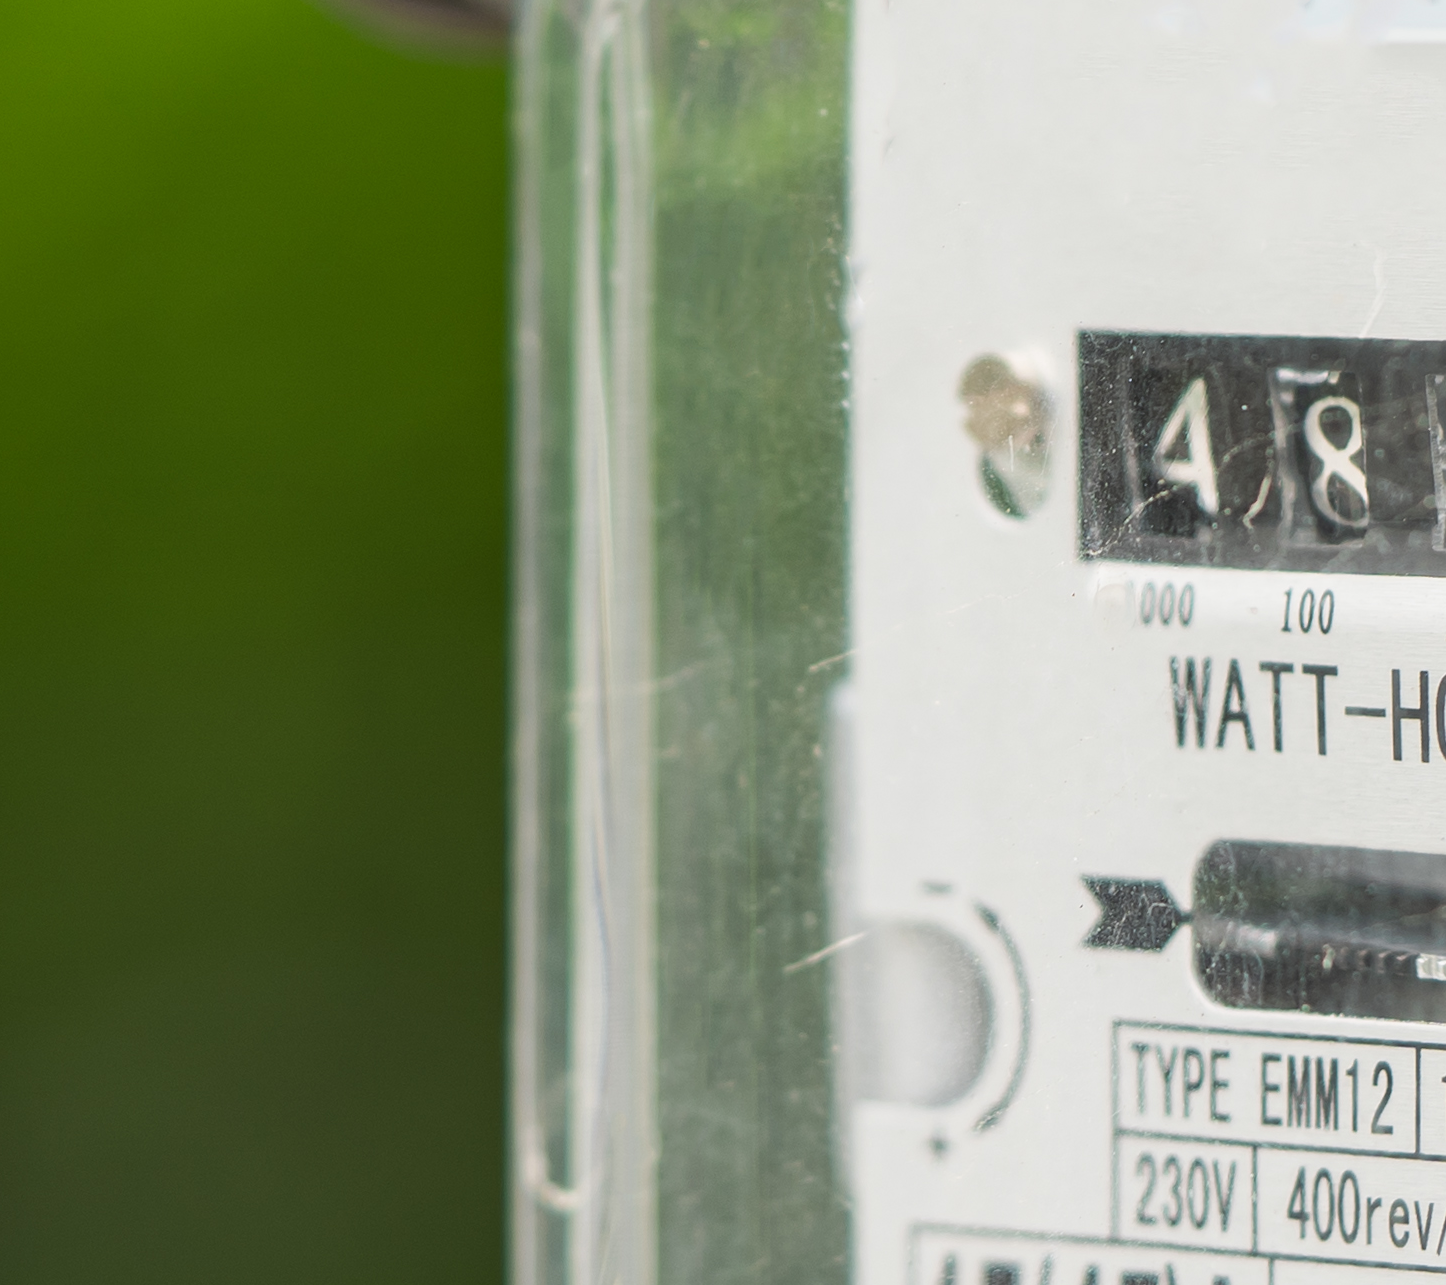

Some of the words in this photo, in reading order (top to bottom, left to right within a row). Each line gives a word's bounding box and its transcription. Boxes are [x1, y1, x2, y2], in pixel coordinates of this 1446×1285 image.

[1126, 581, 1195, 627] 000
[1281, 587, 1335, 635] 100
[1132, 1042, 1233, 1123] TYPE
[1261, 1053, 1394, 1135] EMM12
[1135, 1154, 1237, 1232] 230V
